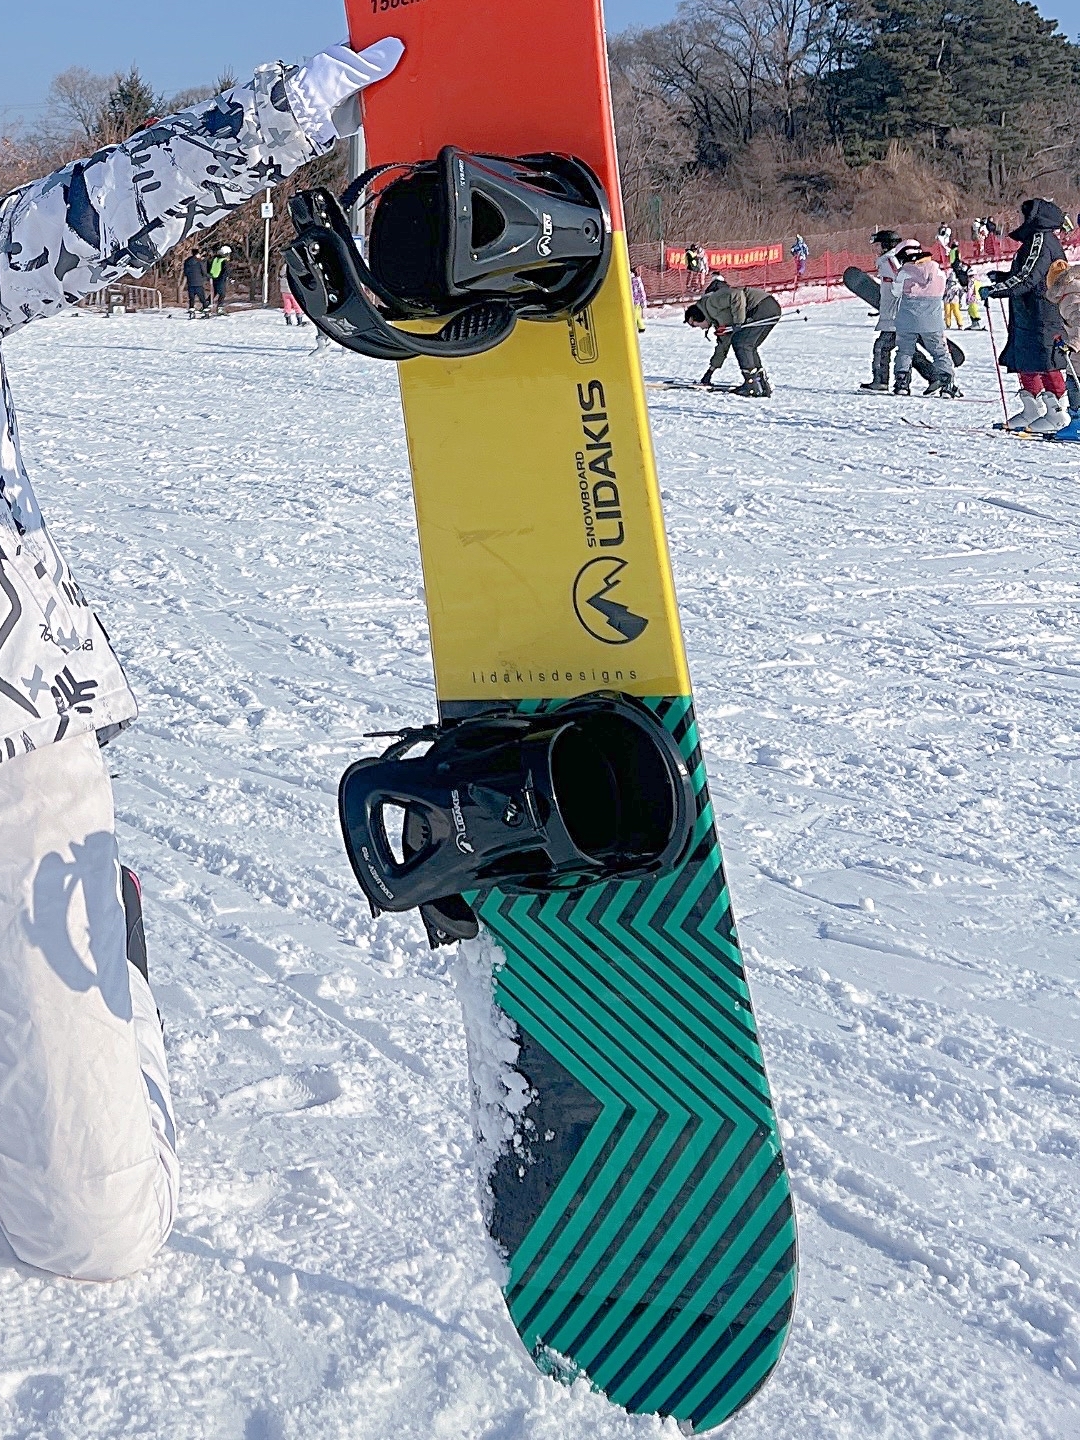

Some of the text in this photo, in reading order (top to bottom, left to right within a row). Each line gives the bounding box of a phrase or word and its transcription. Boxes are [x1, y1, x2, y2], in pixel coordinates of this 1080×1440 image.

[576, 379, 625, 548] LIDAKIS
[575, 451, 597, 548] SNOWBOARD
[472, 669, 637, 683] lidakisdesigns
[451, 789, 467, 834] LIDAKIS
